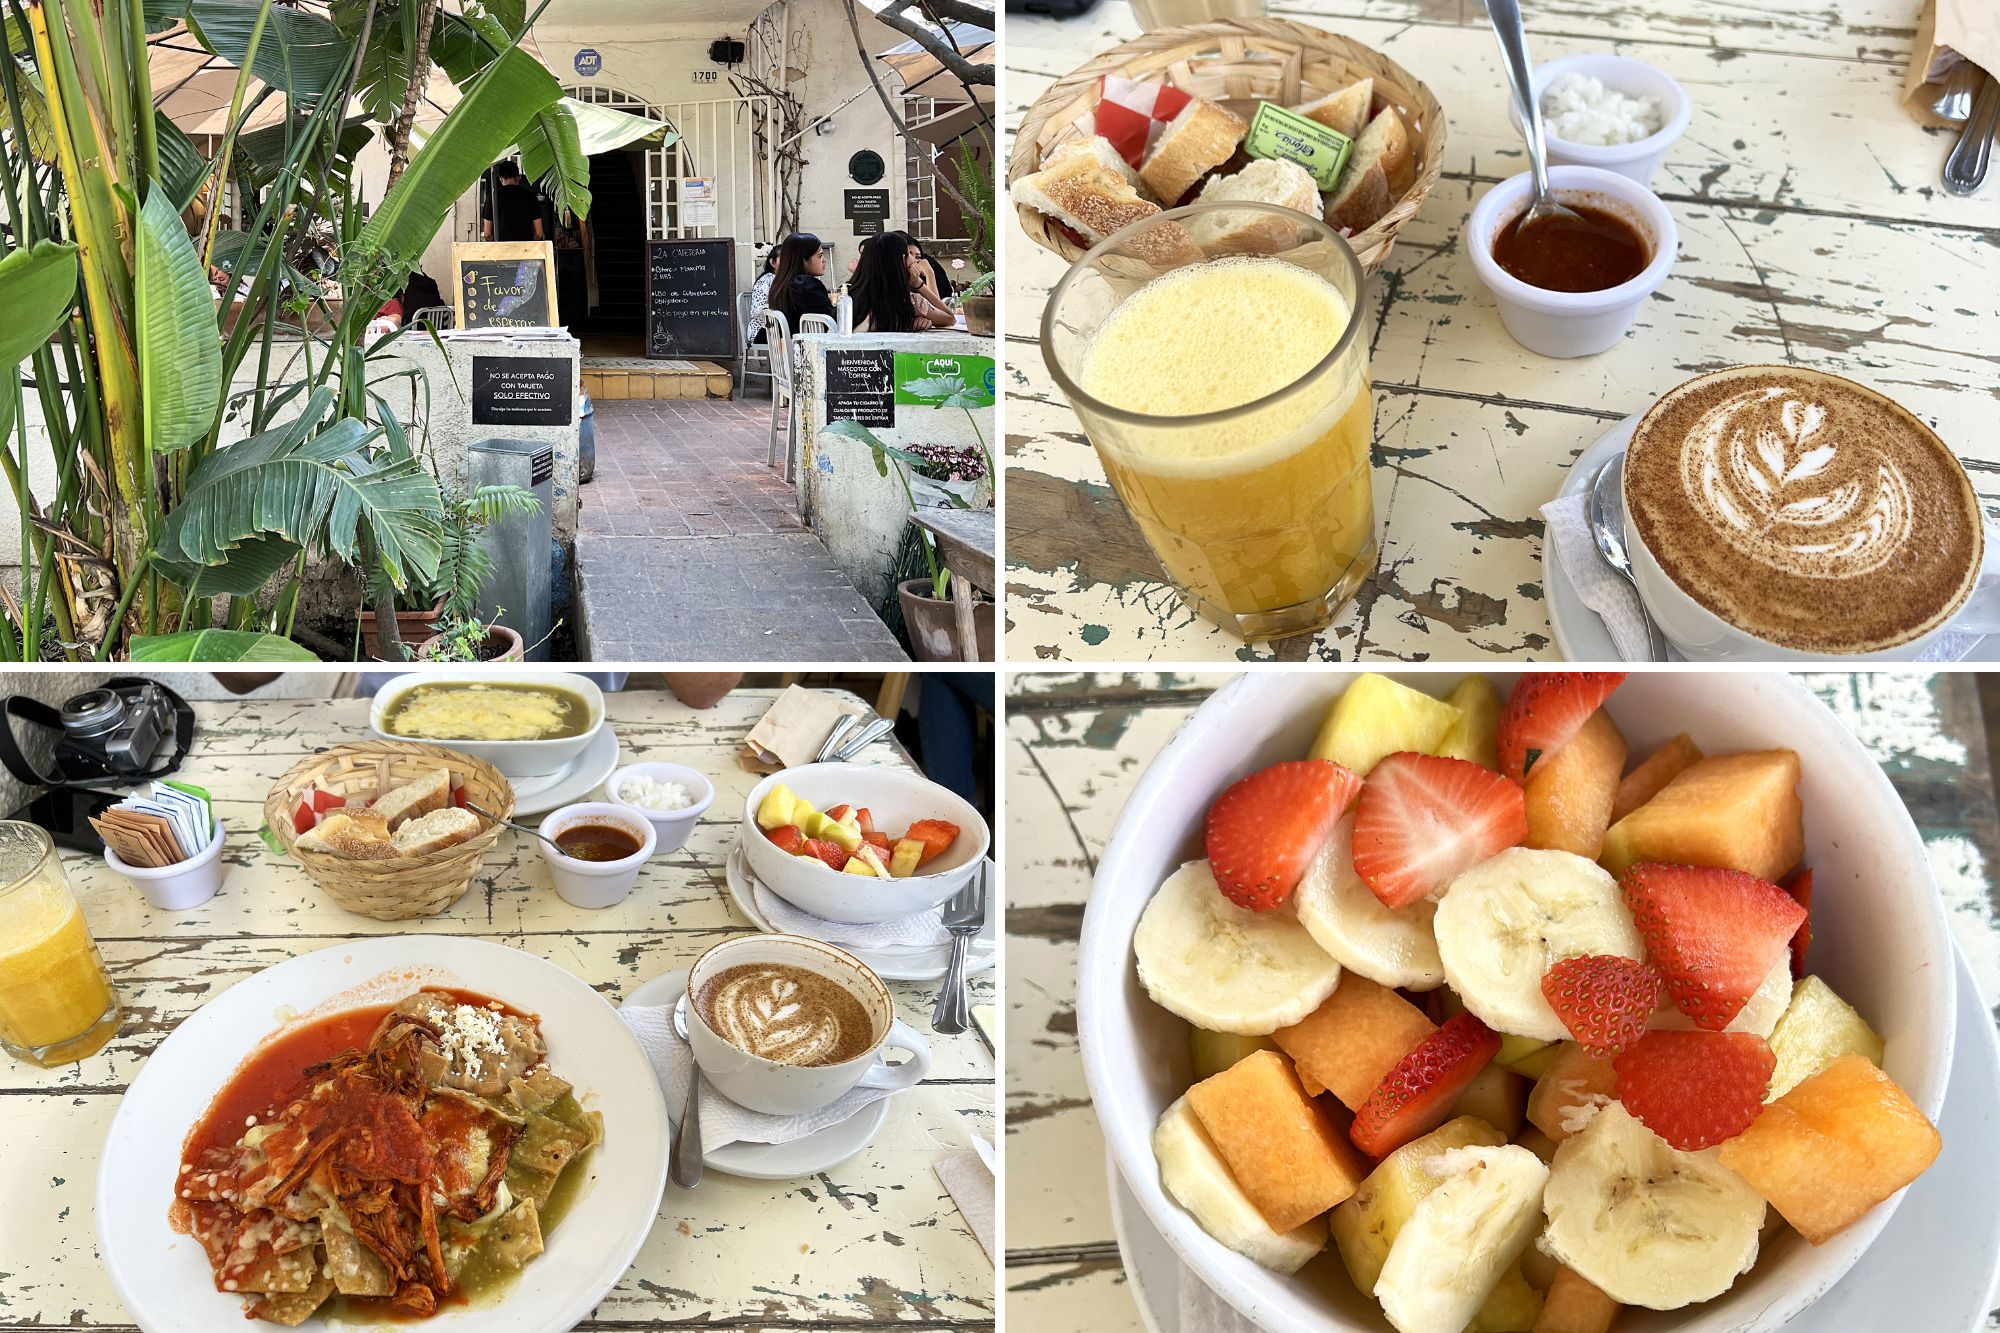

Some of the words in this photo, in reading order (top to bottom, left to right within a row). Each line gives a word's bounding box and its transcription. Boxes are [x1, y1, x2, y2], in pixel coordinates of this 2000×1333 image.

[579, 56, 597, 65] ADT
[693, 71, 717, 80] 1700
[480, 275, 524, 297] Favor
[483, 298, 497, 312] de
[488, 316, 536, 327] esperar
[934, 358, 953, 367] AQUÍ
